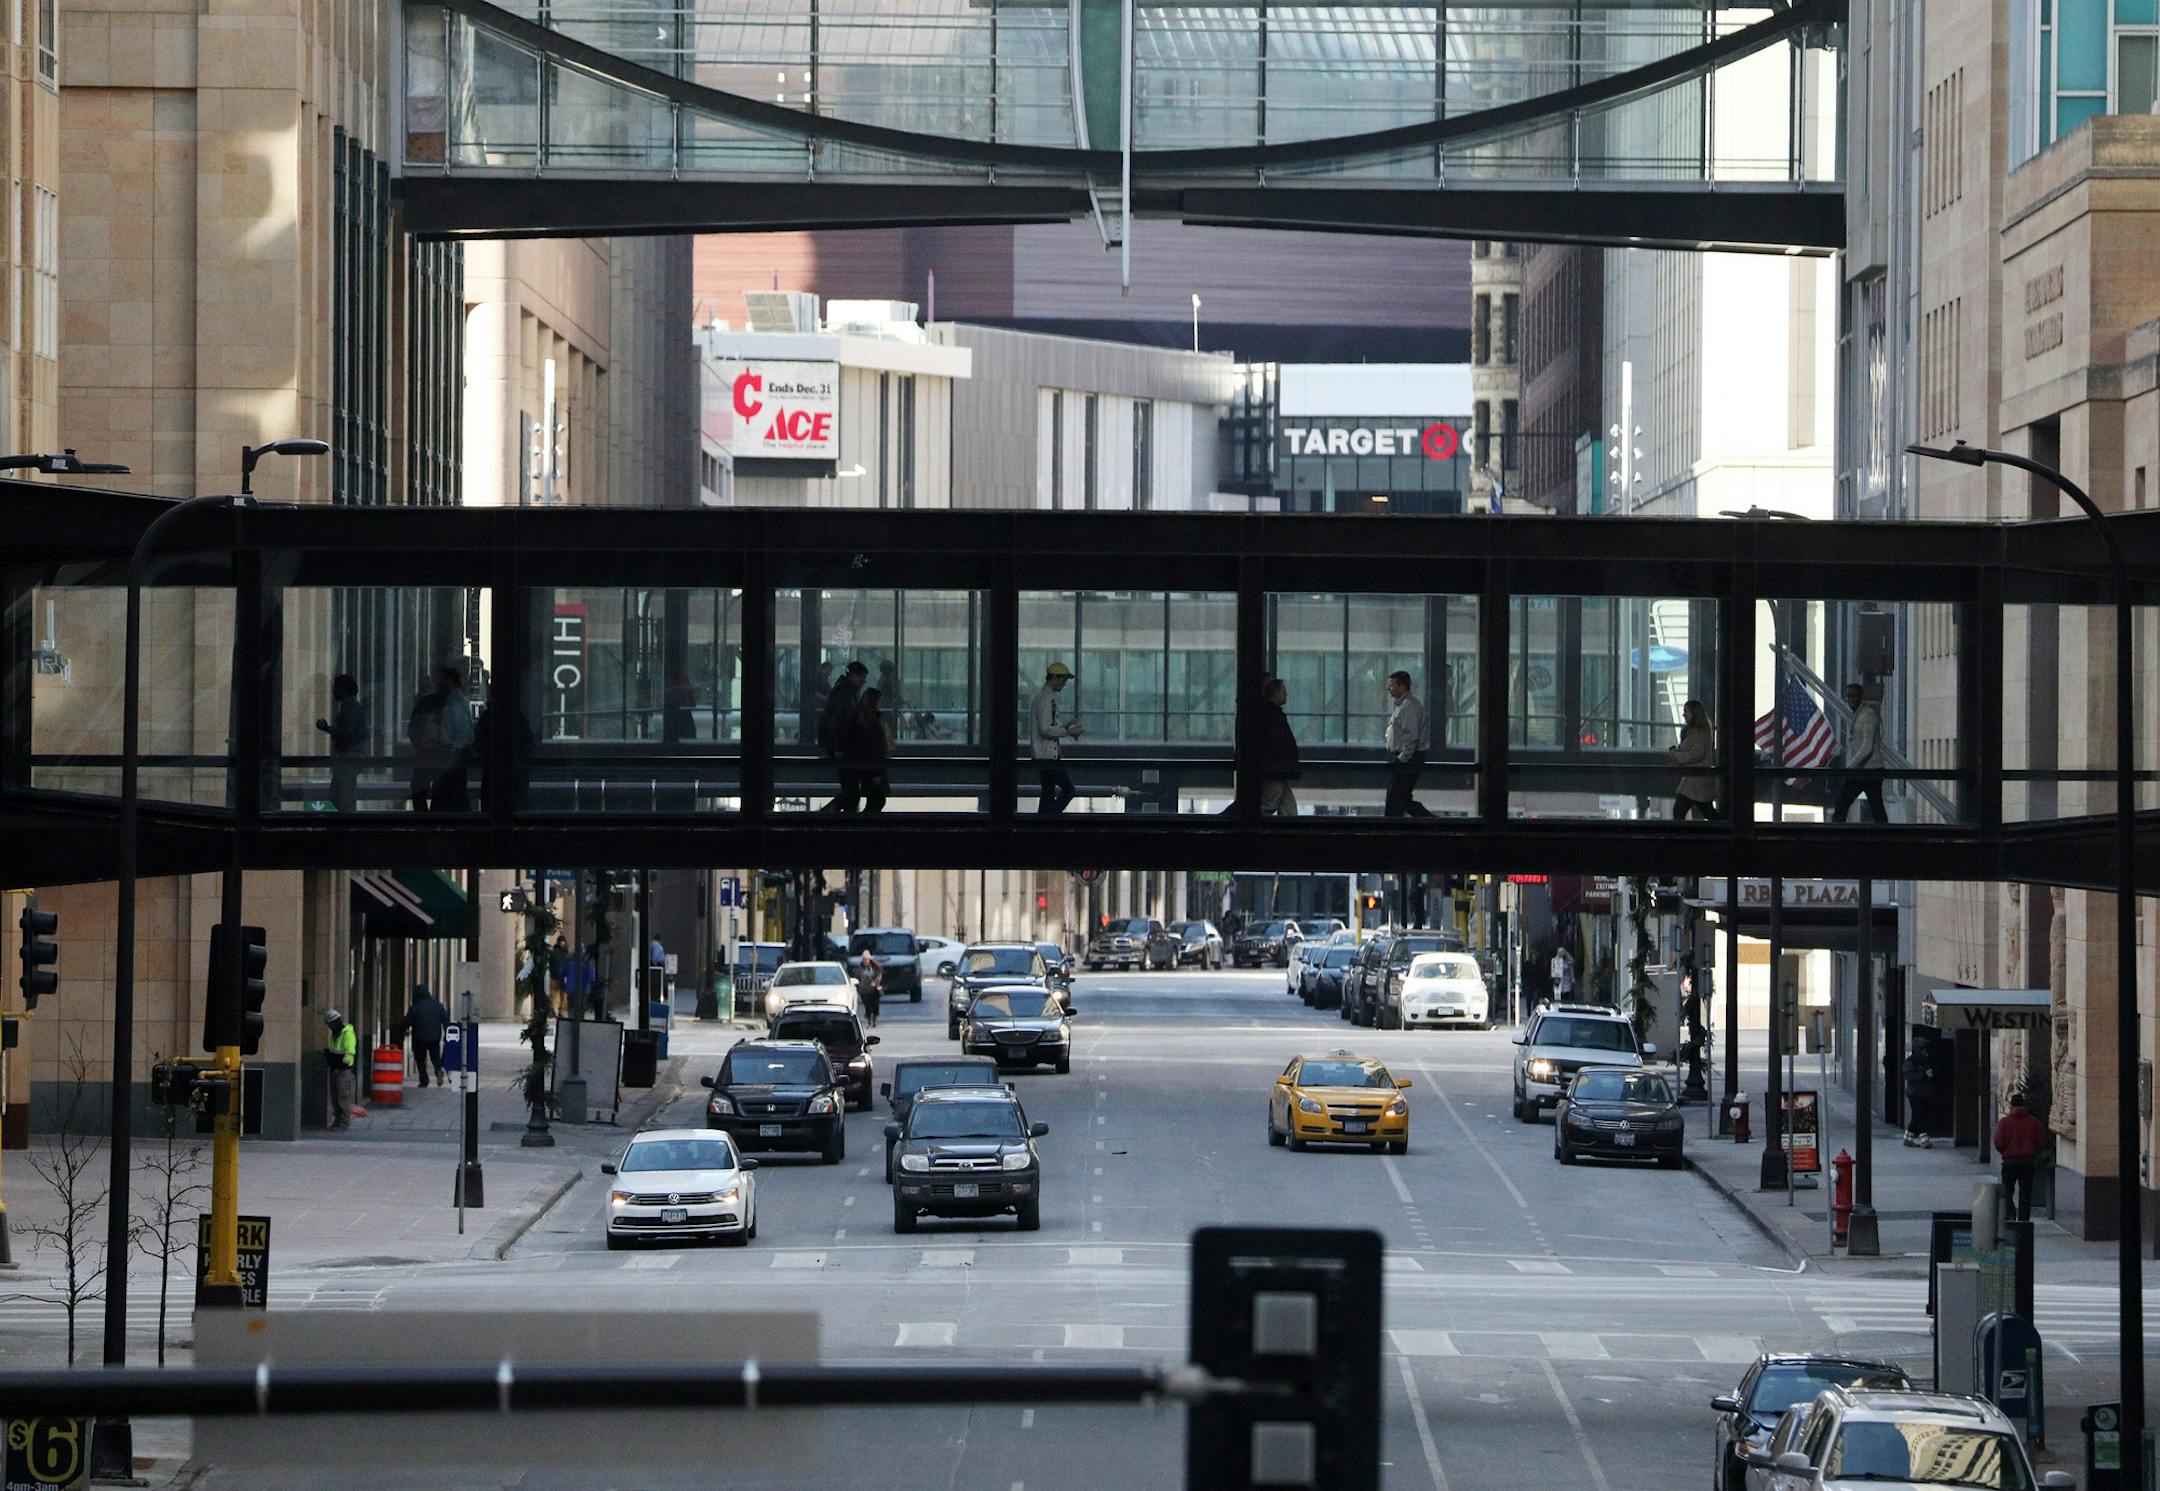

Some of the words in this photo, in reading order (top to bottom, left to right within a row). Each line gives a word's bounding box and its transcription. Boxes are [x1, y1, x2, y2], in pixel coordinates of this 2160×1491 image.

[769, 383, 794, 392] Ends
[797, 384, 818, 393] Dec.
[820, 384, 831, 393] 31
[764, 406, 832, 440] ACE
[1284, 428, 1418, 455] TARGET
[1744, 884, 1785, 901] RB
[1795, 885, 1858, 902] PLAZA
[205, 1223, 264, 1246] RK
[204, 1252, 262, 1269] RLY
